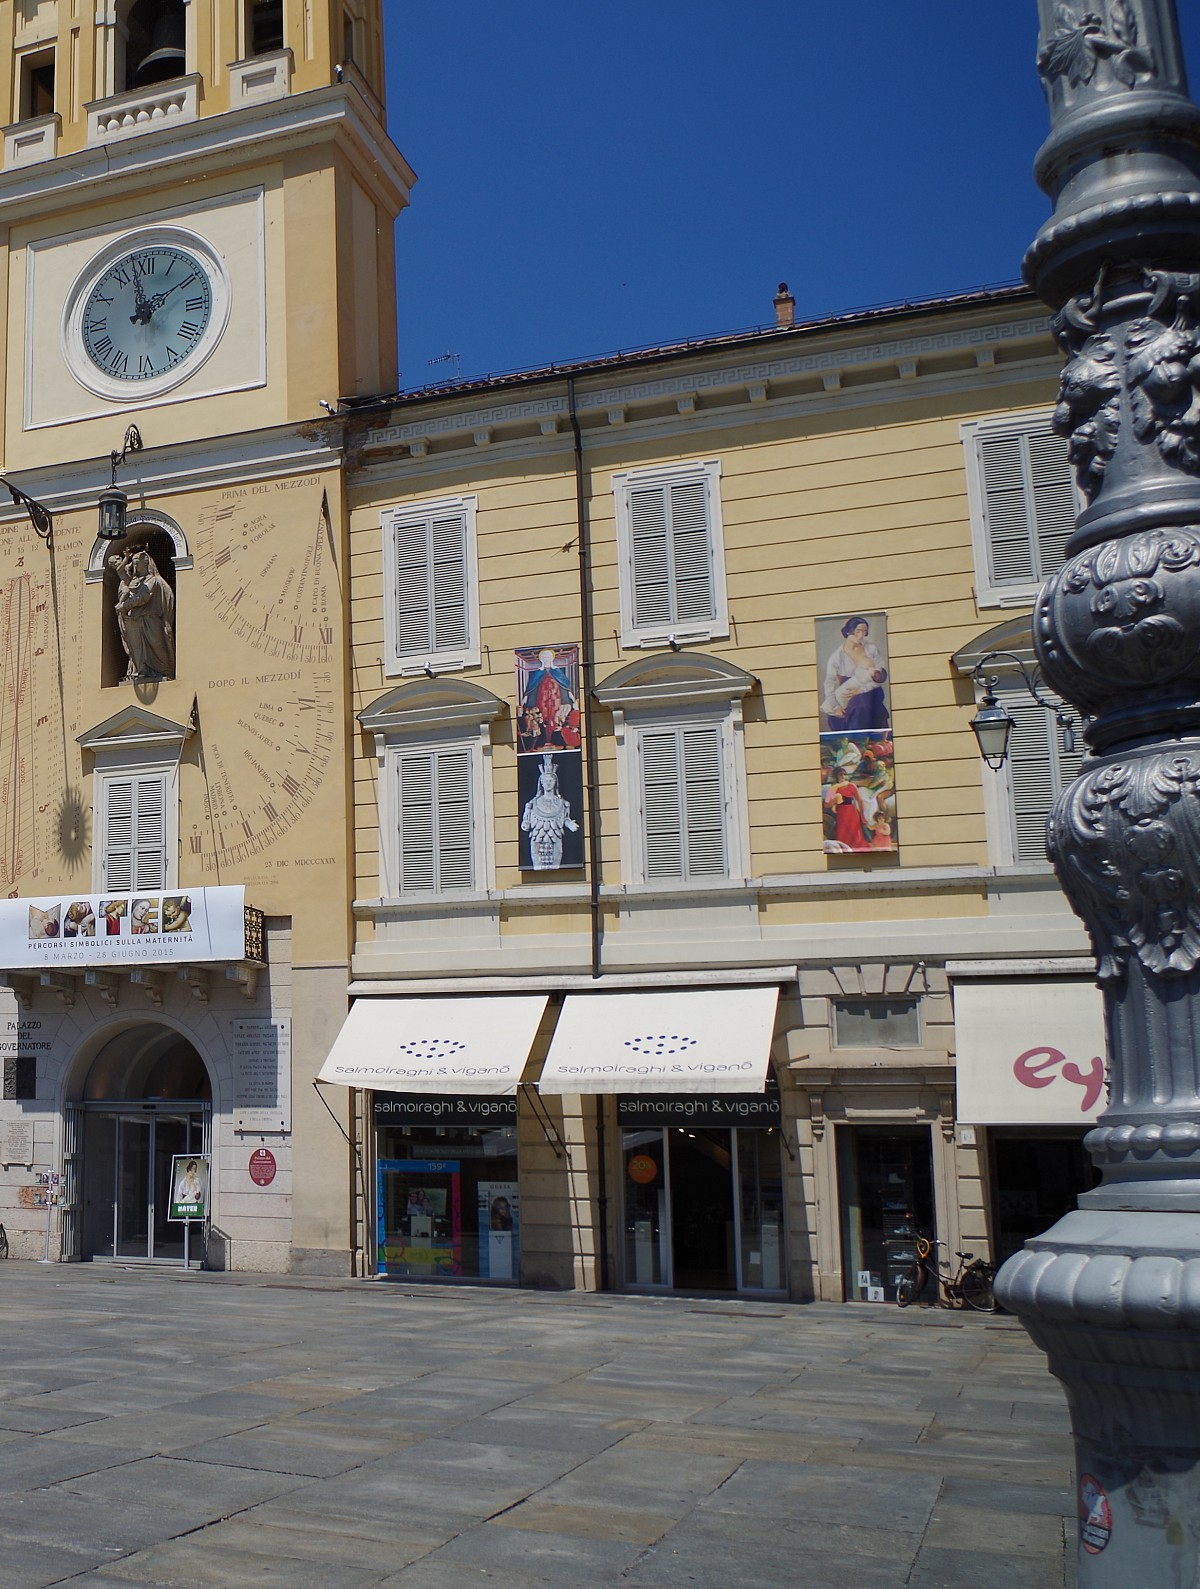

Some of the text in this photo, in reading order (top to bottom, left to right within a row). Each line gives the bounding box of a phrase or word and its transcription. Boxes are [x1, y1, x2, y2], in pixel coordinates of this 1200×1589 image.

[221, 489, 247, 500] PRIMA
[252, 485, 270, 495] DEL
[250, 514, 267, 526] AGRA
[249, 522, 264, 533] GOA
[250, 523, 276, 544] TOBOLSK
[281, 567, 296, 597] MOSKOW
[208, 679, 236, 689] DOPO
[241, 677, 249, 685] IL
[259, 702, 274, 711] LIMA
[253, 712, 278, 725] QUEBEC
[211, 743, 220, 759] PICO
[217, 760, 224, 769] DI
[210, 785, 218, 810] MADRID
[214, 781, 225, 809] LISBONA
[294, 857, 336, 866] MDCCCXXIX
[28, 895, 193, 940] MATER
[28, 934, 193, 950] PERCORSI SIMBOLICI SULLA MATERNITÀ
[44, 953, 49, 961] 8
[53, 952, 85, 960] MARZO
[96, 951, 107, 959] 28
[111, 949, 148, 958] GIUGNO
[152, 948, 174, 956] 2015
[7, 1021, 42, 1030] PALAZZO
[17, 1032, 33, 1040] DEL
[335, 1066, 433, 1077] salmoiraghi
[436, 1066, 447, 1075] &
[558, 1063, 666, 1075] salmoiraghi
[671, 1064, 684, 1072] &
[1013, 1046, 1104, 1112] ey
[374, 1101, 454, 1116] salmoiraghi
[457, 1102, 467, 1113] &
[619, 1099, 708, 1115] salmoiraghi
[712, 1100, 724, 1112] &
